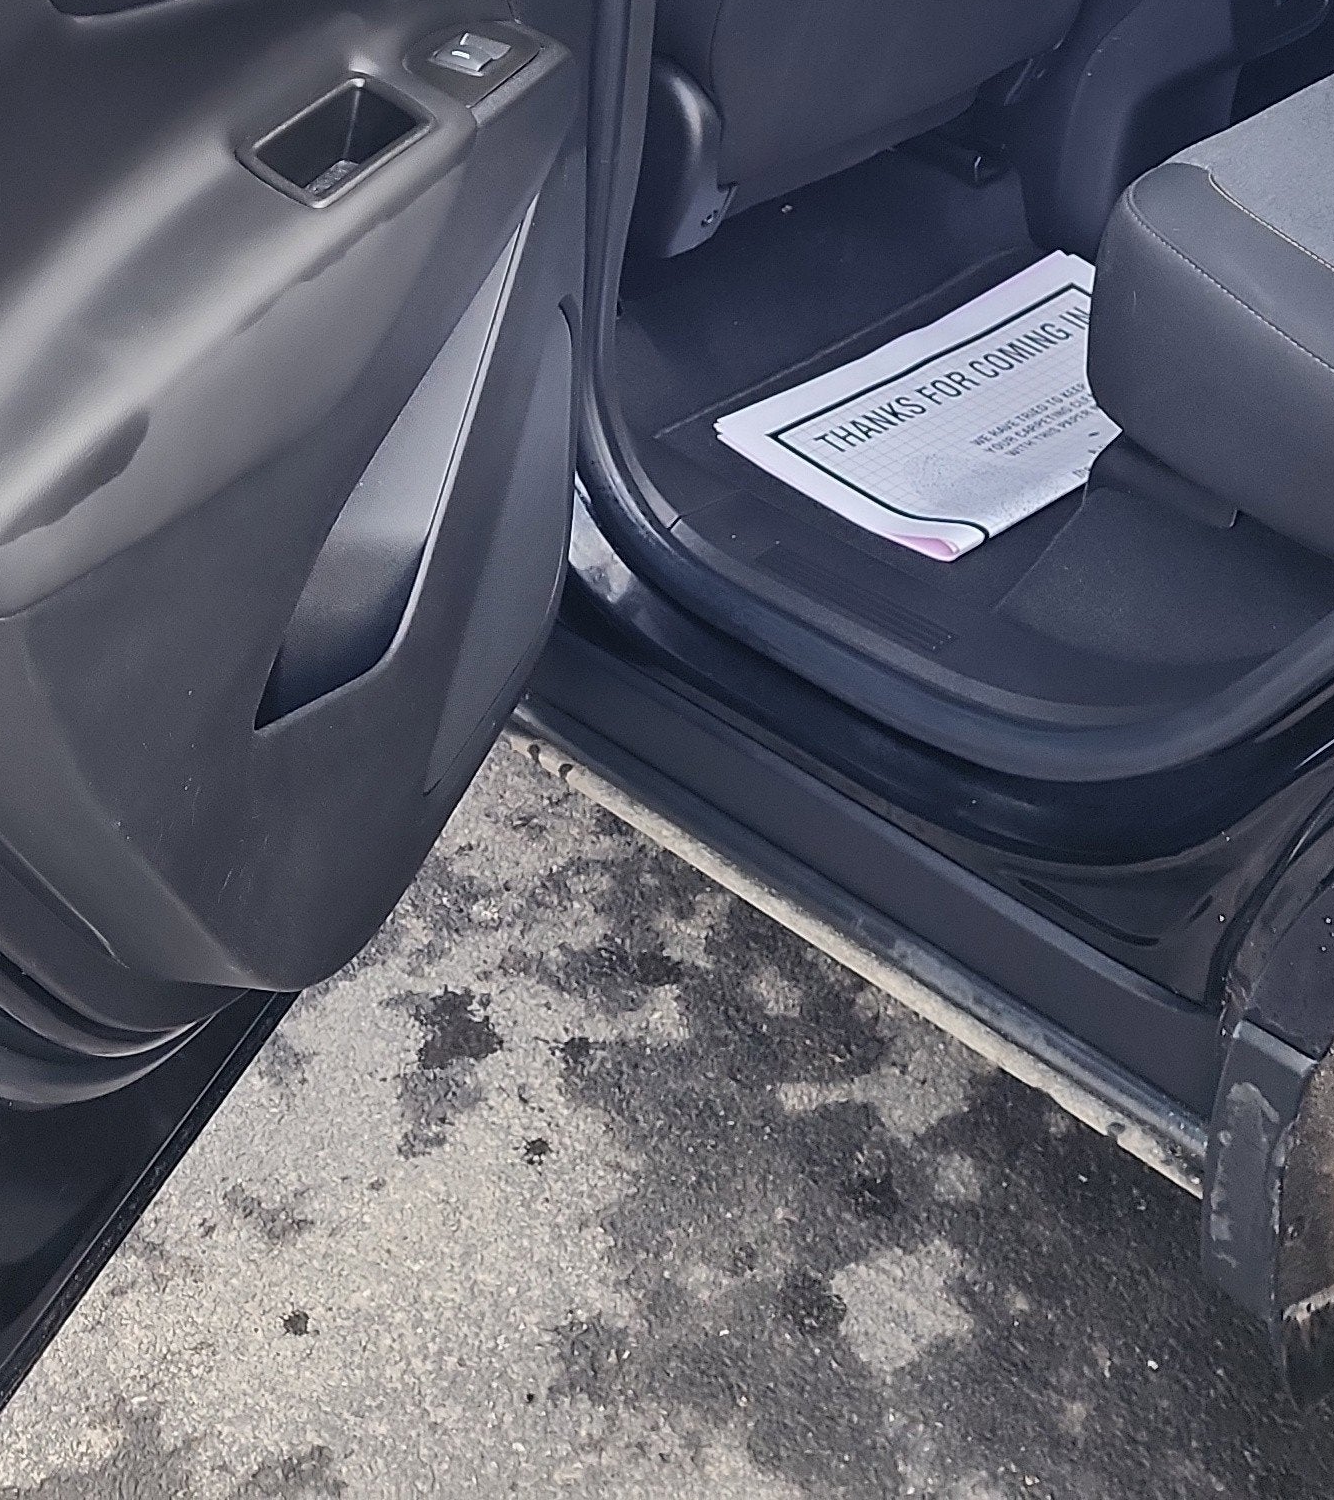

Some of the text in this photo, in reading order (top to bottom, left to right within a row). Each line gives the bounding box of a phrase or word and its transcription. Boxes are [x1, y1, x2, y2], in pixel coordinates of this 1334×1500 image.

[814, 396, 927, 452] THANKS
[915, 371, 980, 405] FOR
[968, 323, 1074, 378] COMING
[970, 434, 992, 446] WE
[1046, 395, 1064, 406] TO
